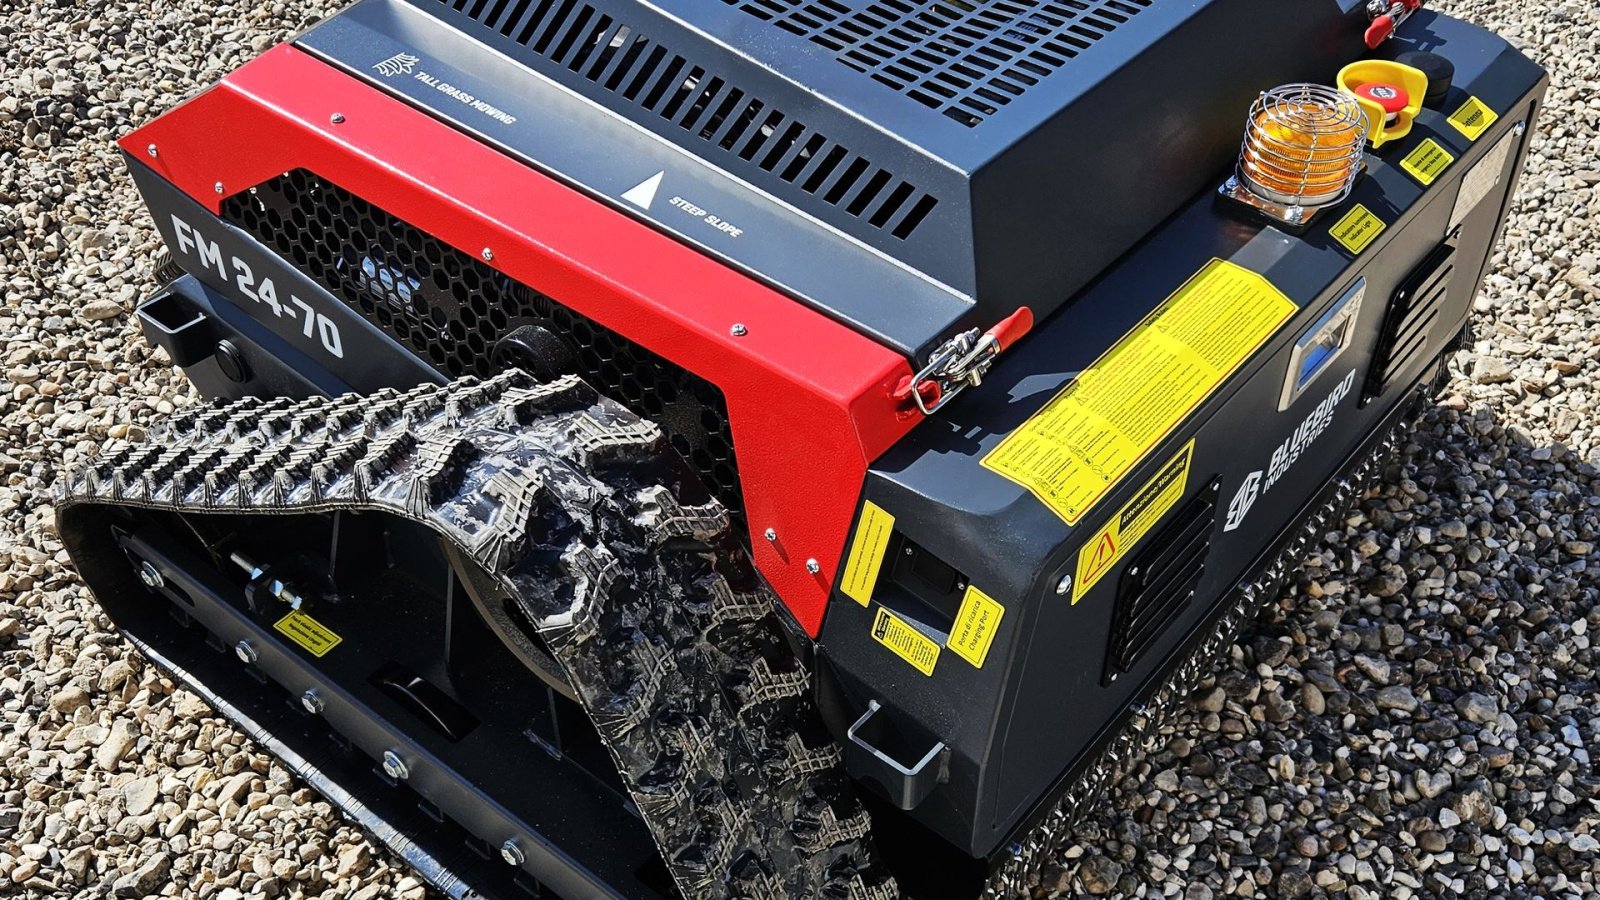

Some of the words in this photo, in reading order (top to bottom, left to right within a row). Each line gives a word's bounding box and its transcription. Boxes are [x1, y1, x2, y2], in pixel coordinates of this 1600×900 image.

[414, 71, 439, 88] TALL
[436, 83, 474, 103] GRASS
[469, 99, 517, 124] MOWING
[669, 196, 707, 216] STEEP
[704, 215, 743, 238] SLOPE
[171, 213, 228, 281] FM
[231, 256, 343, 359] 24-70
[1267, 368, 1356, 477] BLUEBIRD
[1262, 410, 1334, 495] INDUSTRIES
[958, 629, 968, 646] Porta
[968, 600, 981, 624] ricarica
[968, 621, 985, 651] Charging
[980, 610, 990, 624] Port
